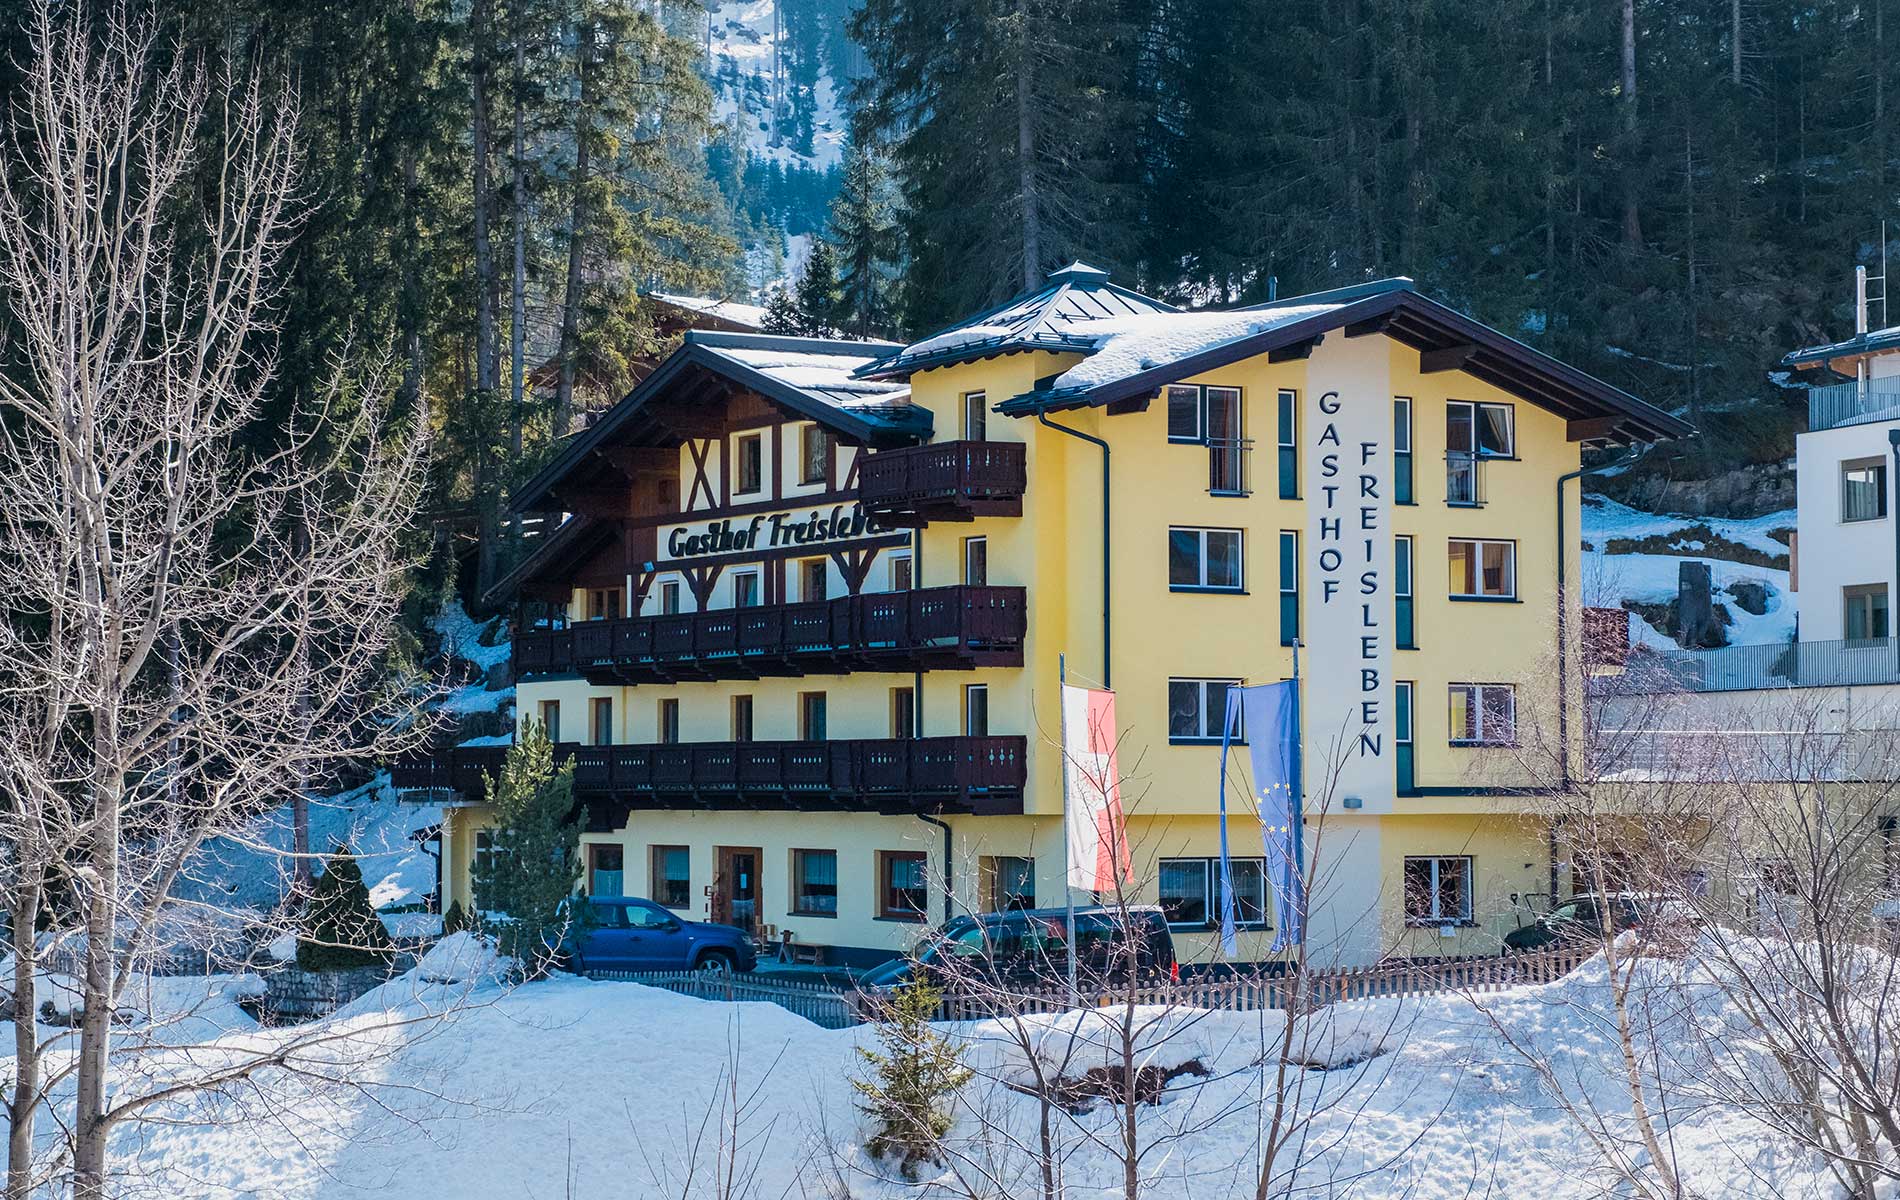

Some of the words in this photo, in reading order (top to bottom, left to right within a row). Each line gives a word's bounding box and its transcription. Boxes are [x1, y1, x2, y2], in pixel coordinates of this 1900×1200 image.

[668, 515, 766, 557] Gasthof
[768, 501, 896, 546] Freislebe
[1318, 391, 1342, 604] GASTHOF
[1359, 441, 1381, 757] FREISLEBEN
